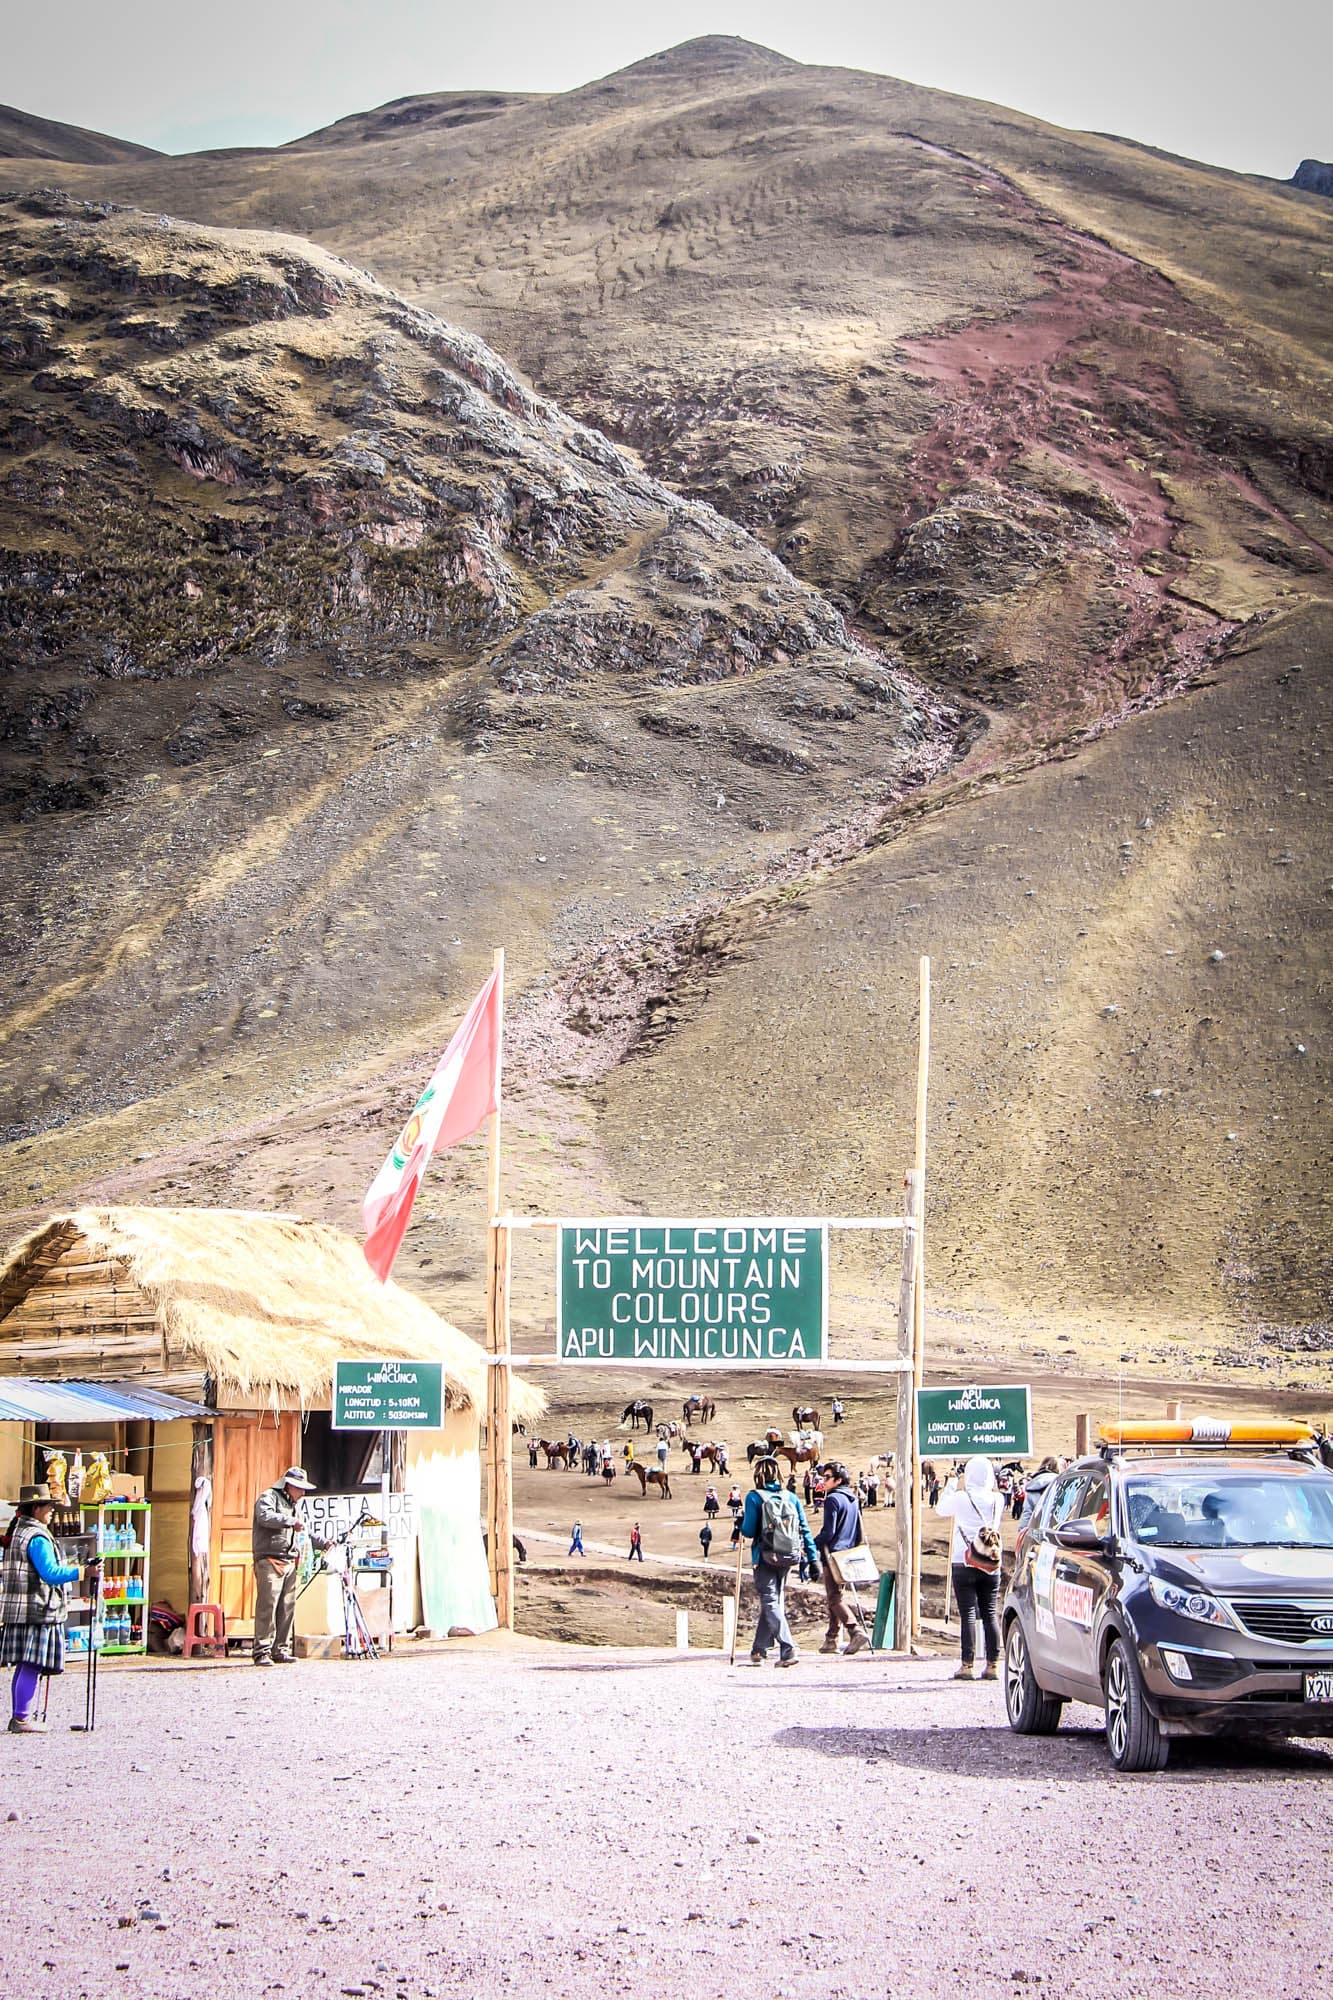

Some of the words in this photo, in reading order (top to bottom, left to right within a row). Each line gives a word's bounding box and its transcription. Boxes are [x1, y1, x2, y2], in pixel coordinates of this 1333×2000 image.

[575, 1228, 807, 1255] WELLCOME
[573, 1259, 611, 1288] TO
[632, 1258, 800, 1289] MOUNTAIN
[612, 1293, 771, 1323] COLOURS
[565, 1328, 614, 1357] APU
[634, 1327, 807, 1359] WINICUNCA
[381, 1363, 400, 1373] APU
[367, 1373, 418, 1384] WINICUNCA
[339, 1385, 372, 1394] MIRADOR
[962, 1388, 982, 1400] APU
[948, 1399, 1001, 1410] WINICUNCA
[344, 1411, 375, 1420] ALTITUD
[928, 1434, 959, 1444] ALTITUD
[301, 1496, 369, 1520] ASETA
[389, 1494, 413, 1514] DE
